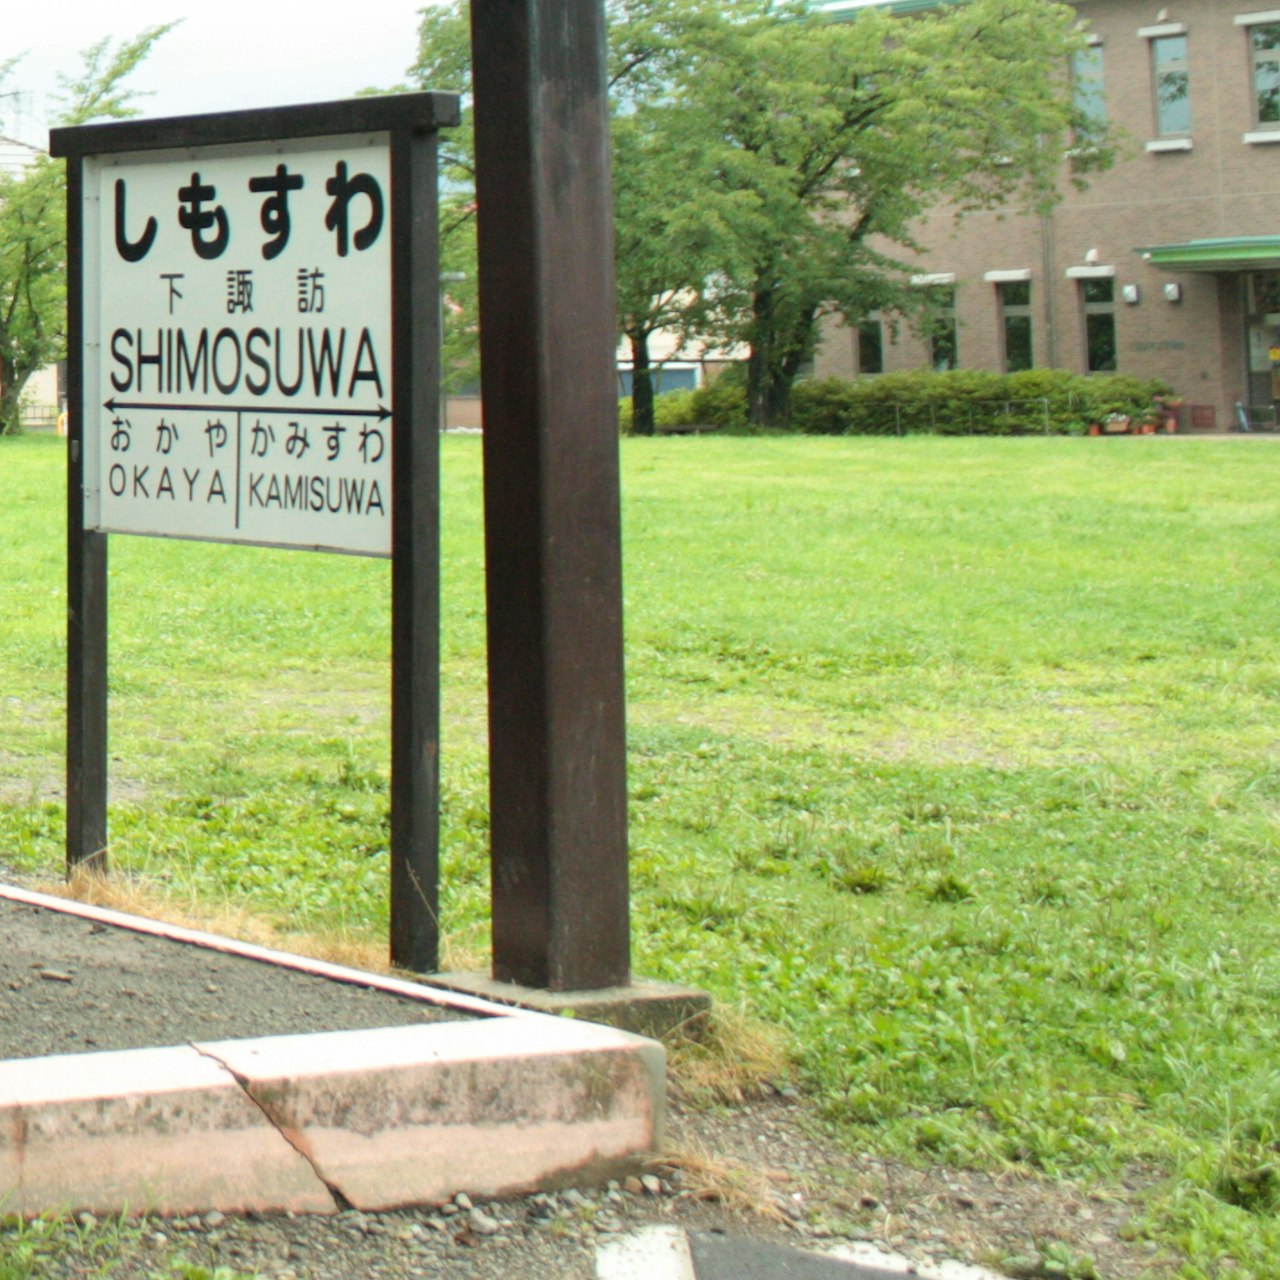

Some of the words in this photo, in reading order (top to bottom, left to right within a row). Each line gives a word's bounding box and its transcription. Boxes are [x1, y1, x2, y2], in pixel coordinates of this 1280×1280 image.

[114, 160, 384, 263] しもすわ
[159, 267, 325, 315] 下諏訪
[110, 326, 384, 399] SHIMOSUWA
[111, 416, 227, 458] おかや
[250, 421, 384, 464] かみすわ
[109, 463, 226, 503] OKAYA
[249, 473, 385, 516] KAMISUWA
